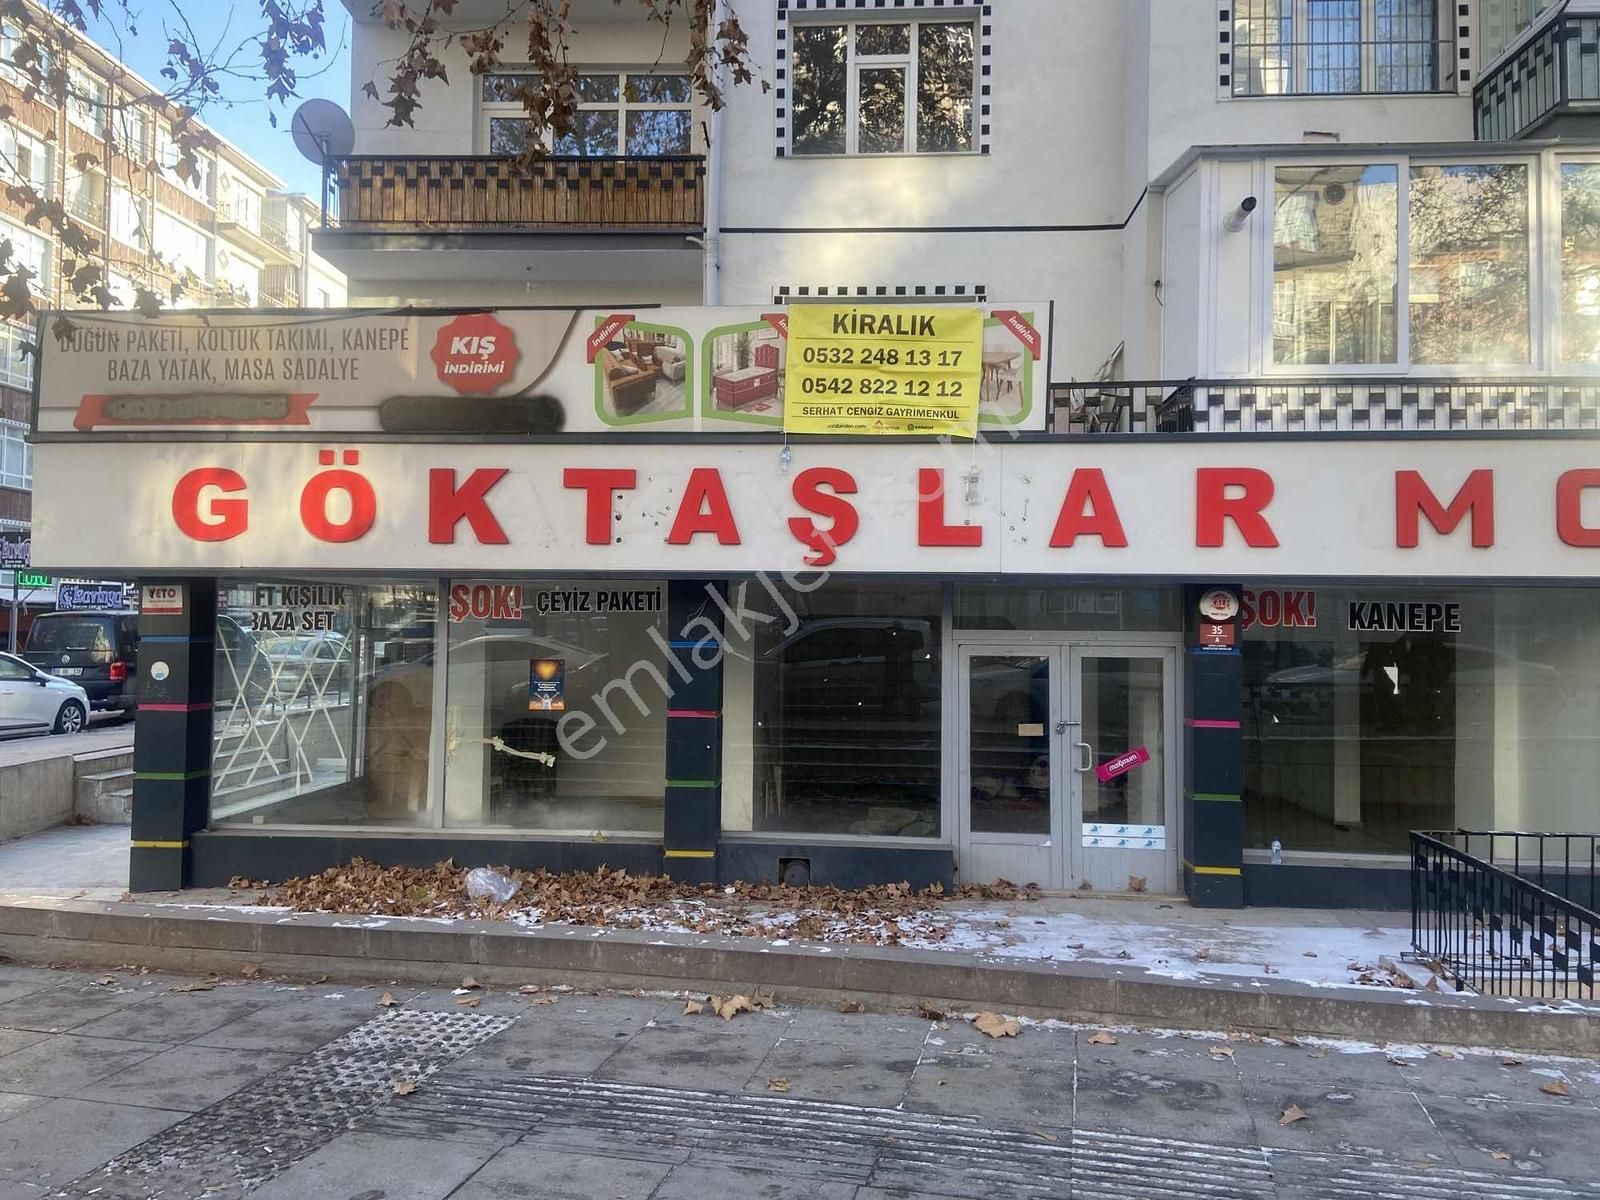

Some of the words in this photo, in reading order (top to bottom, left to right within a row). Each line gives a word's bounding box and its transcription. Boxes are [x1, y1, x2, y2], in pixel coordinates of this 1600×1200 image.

[833, 308, 935, 336] KİRALIK
[126, 328, 189, 354] PAKETİ,
[197, 328, 260, 351] KOLTUK
[267, 328, 334, 353] TAKIMI,
[342, 328, 409, 350] KANEPE
[450, 336, 496, 360] KIŞ
[444, 361, 505, 374] İNDİRİMİ
[803, 347, 854, 364] 0532
[860, 348, 899, 365] 248
[905, 350, 931, 366] 13
[937, 350, 962, 367] 17
[108, 359, 151, 381] BAZA
[158, 358, 216, 384] YATAK,
[225, 358, 275, 380] MASA
[283, 357, 359, 380] SADALYE
[802, 377, 853, 394] 0542
[859, 378, 897, 395] 822
[904, 380, 930, 396] 12
[936, 381, 963, 397] 12
[802, 406, 843, 416] SERHAT
[847, 406, 883, 416] CENGİZ
[886, 408, 959, 419] GAYRİMENKUL
[172, 449, 1280, 567] GÖKTAŞLAR
[149, 588, 176, 598] VETO
[252, 585, 275, 606] FT
[281, 585, 346, 608] KİŞİLİK
[451, 584, 522, 623] ŞOK!
[537, 587, 591, 615] ÇEYİZ
[597, 586, 662, 612] PAKETİ
[301, 611, 335, 631] SET
[1242, 590, 1317, 631] ŞOK!
[1348, 601, 1462, 632] KANEPE
[1212, 625, 1223, 635] 35
